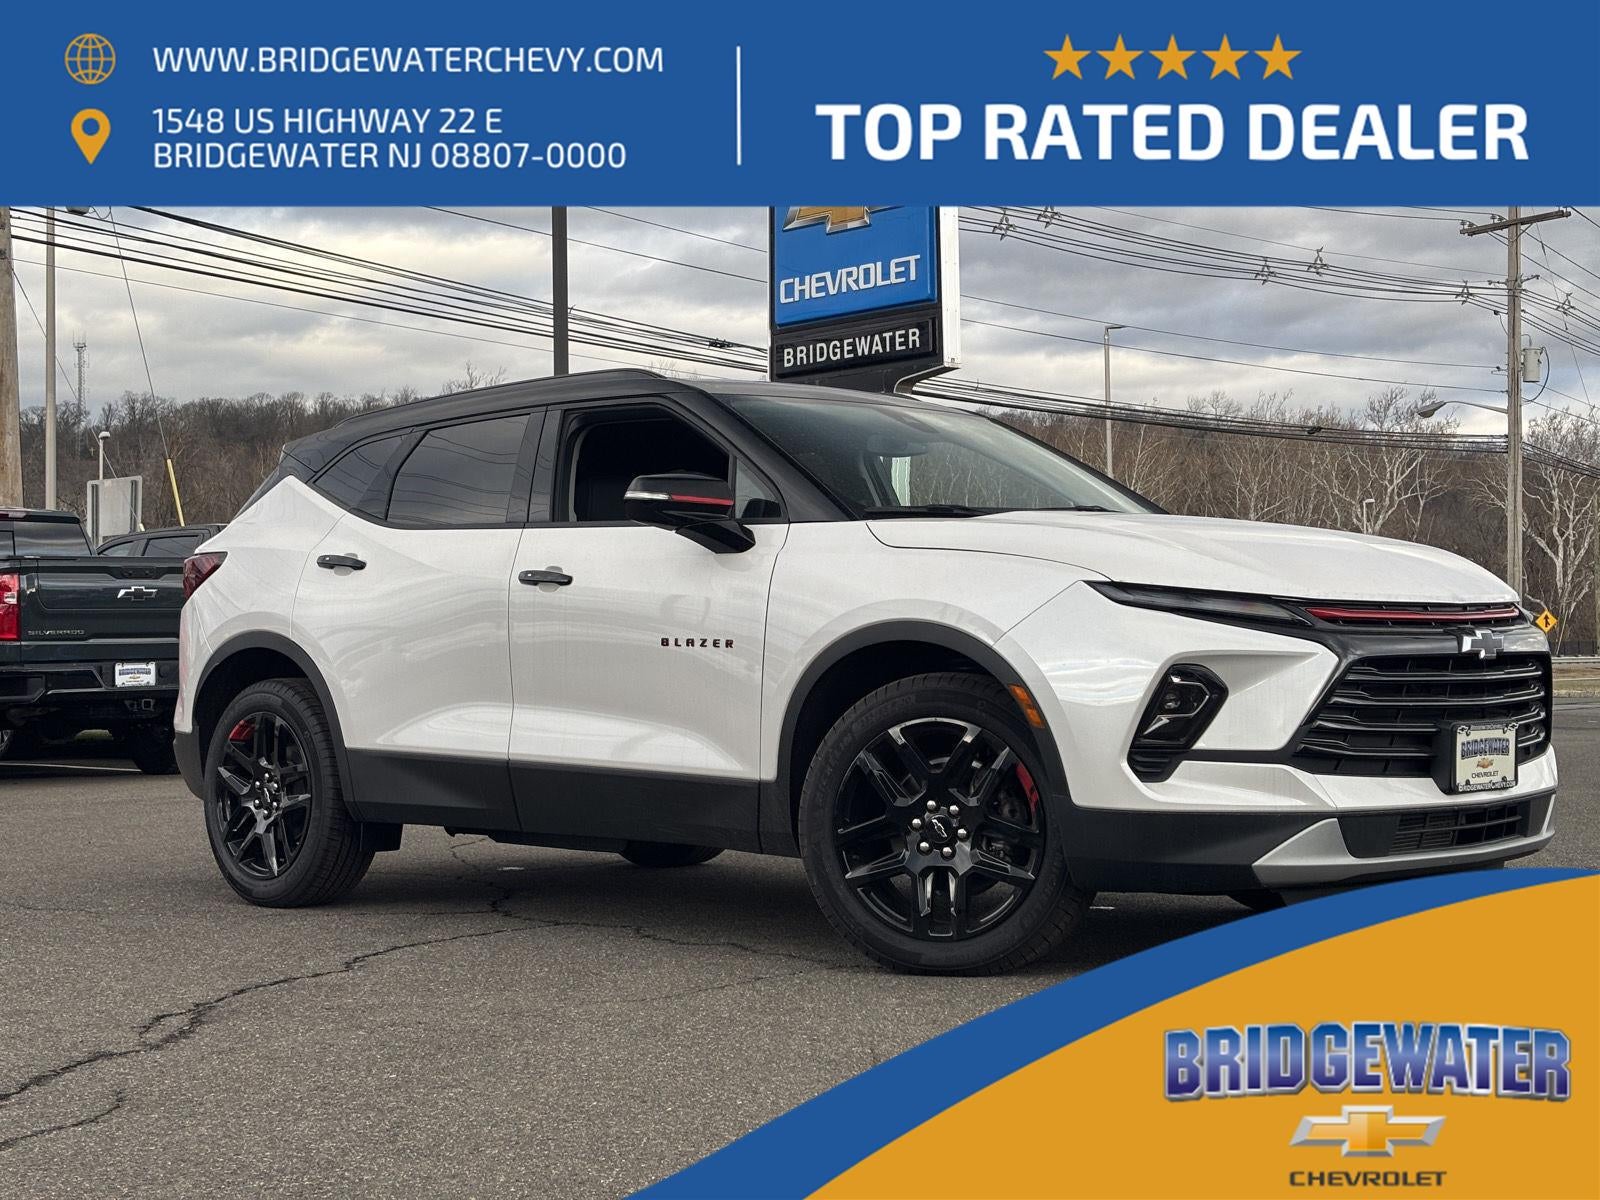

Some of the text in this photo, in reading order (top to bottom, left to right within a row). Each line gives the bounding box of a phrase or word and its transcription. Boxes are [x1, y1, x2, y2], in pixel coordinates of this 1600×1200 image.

[780, 254, 921, 304] CHEVROLET
[783, 328, 920, 368] BRIDGEWATER
[660, 637, 734, 648] BLAZER
[1461, 738, 1509, 759] BRIDGEWATER
